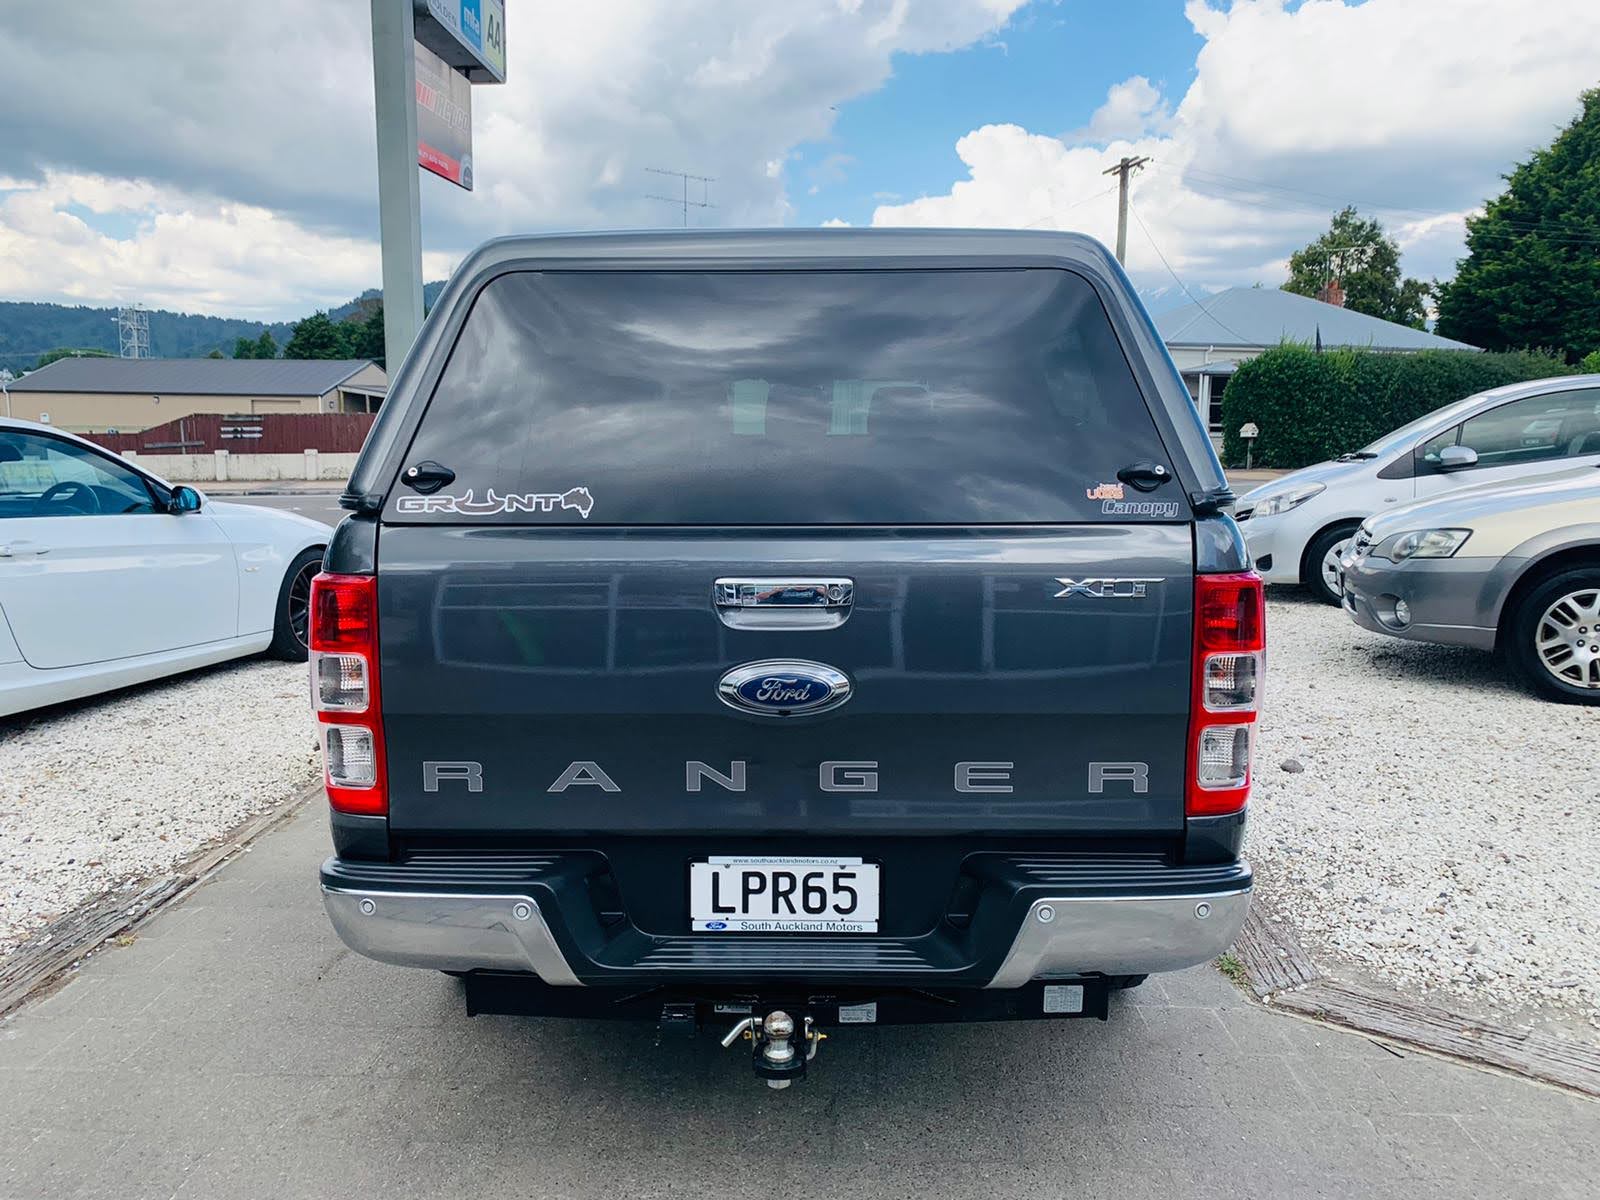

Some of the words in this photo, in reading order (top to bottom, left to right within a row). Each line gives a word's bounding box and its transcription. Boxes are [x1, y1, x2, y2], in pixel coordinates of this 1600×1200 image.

[487, 14, 501, 55] AA
[397, 488, 563, 515] GRUNT
[1102, 500, 1179, 517] Canopy
[1054, 577, 1166, 597] XLT
[756, 677, 811, 701] Ford
[423, 760, 1148, 793] RANGER
[732, 857, 838, 865] www.southaucklandmotors.co.nz
[712, 871, 858, 915] LPR65
[740, 921, 772, 931] South
[775, 921, 823, 931] Auckland
[826, 922, 863, 932] Motors
